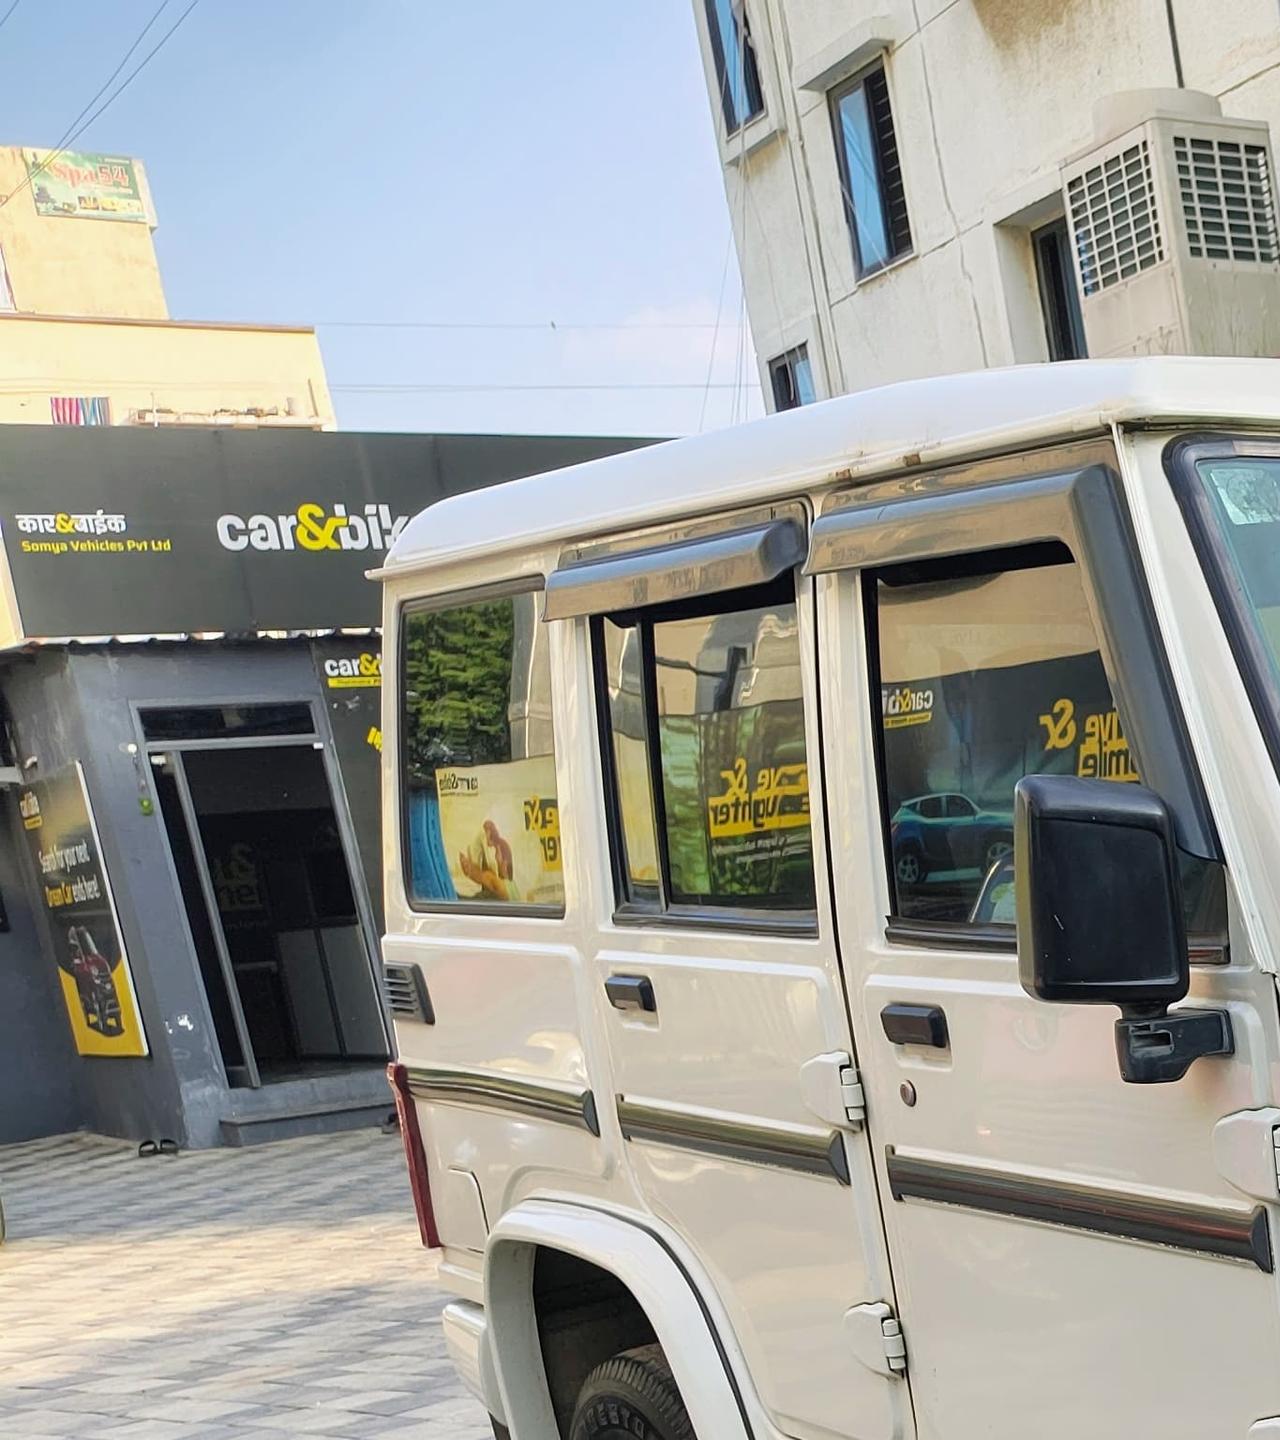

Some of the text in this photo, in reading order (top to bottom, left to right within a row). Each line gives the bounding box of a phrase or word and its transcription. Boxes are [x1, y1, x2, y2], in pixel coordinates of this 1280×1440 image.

[97, 163, 130, 188] 54
[21, 538, 172, 554] Somya Vehicles Pvt Ltd
